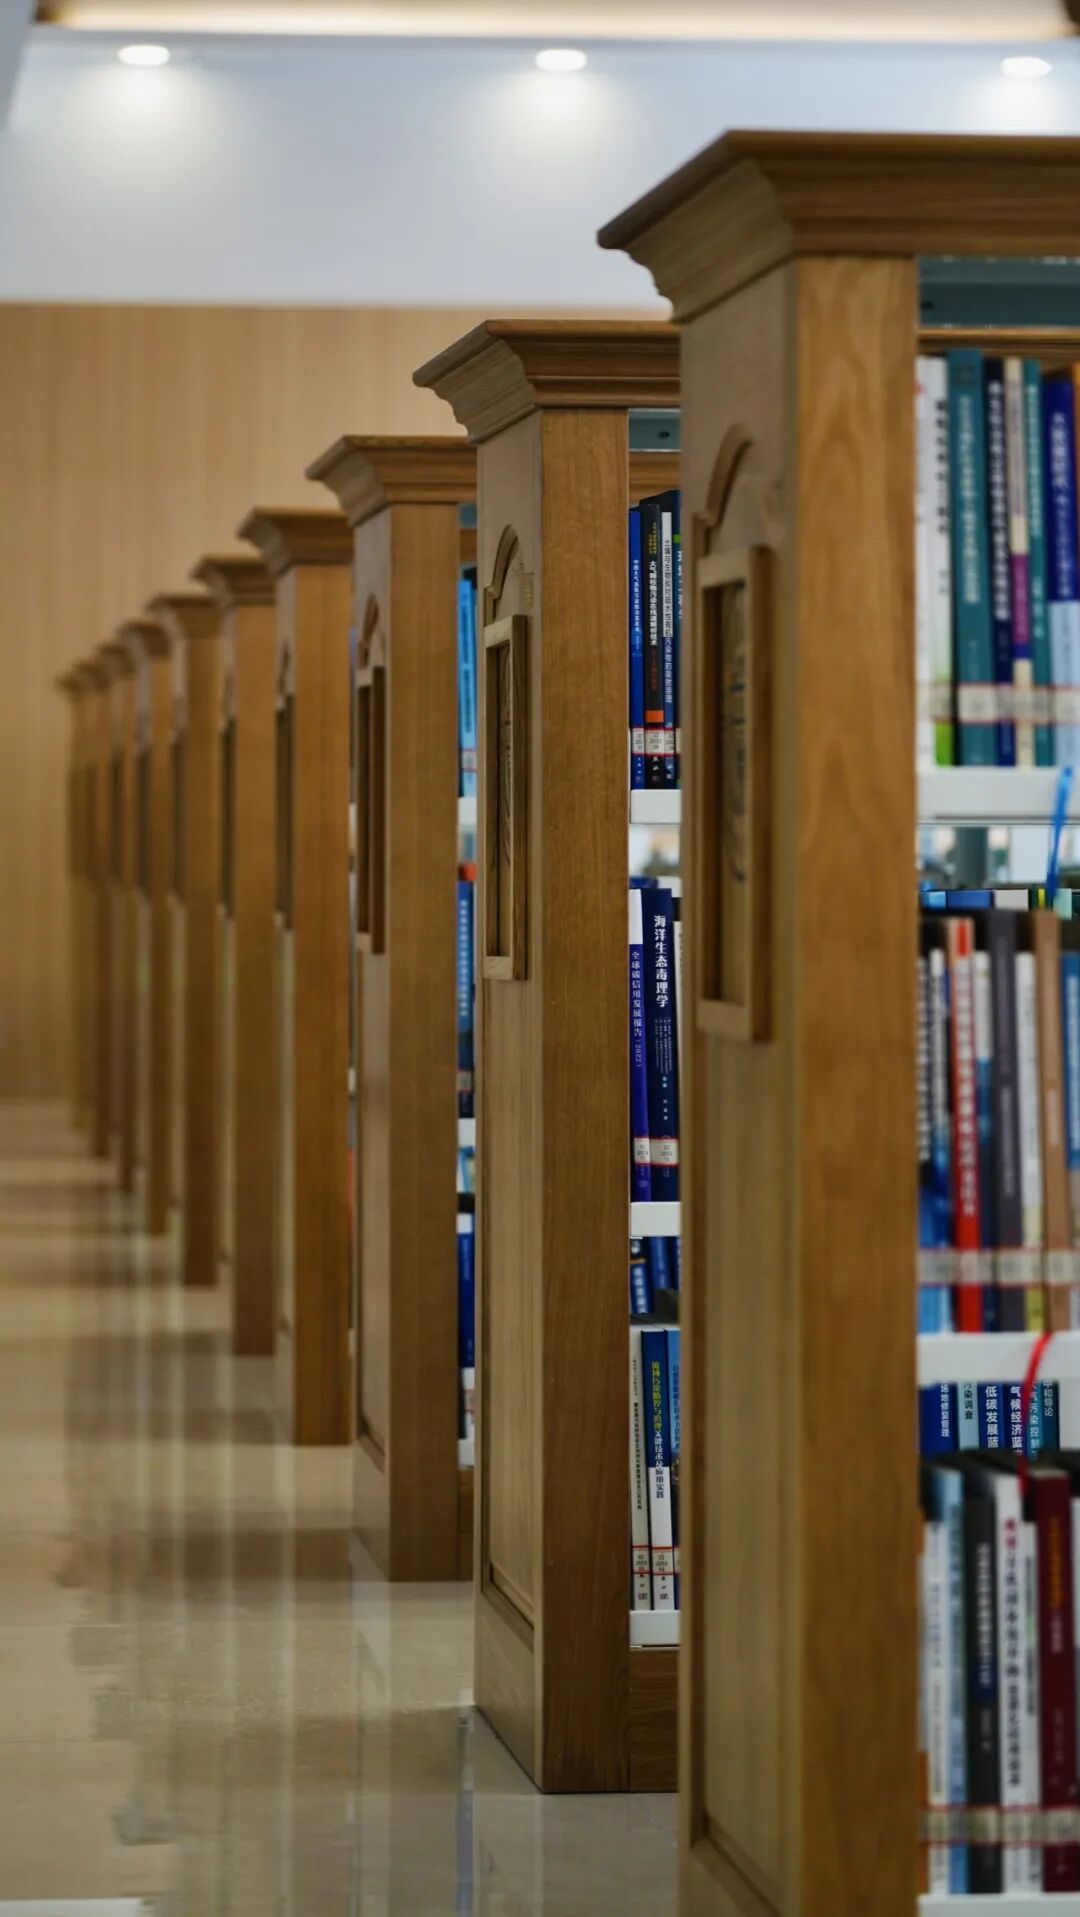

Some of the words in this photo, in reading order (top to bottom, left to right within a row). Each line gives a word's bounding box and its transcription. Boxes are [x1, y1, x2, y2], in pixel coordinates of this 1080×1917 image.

[654, 915, 669, 1008] 海洋生态毒理学
